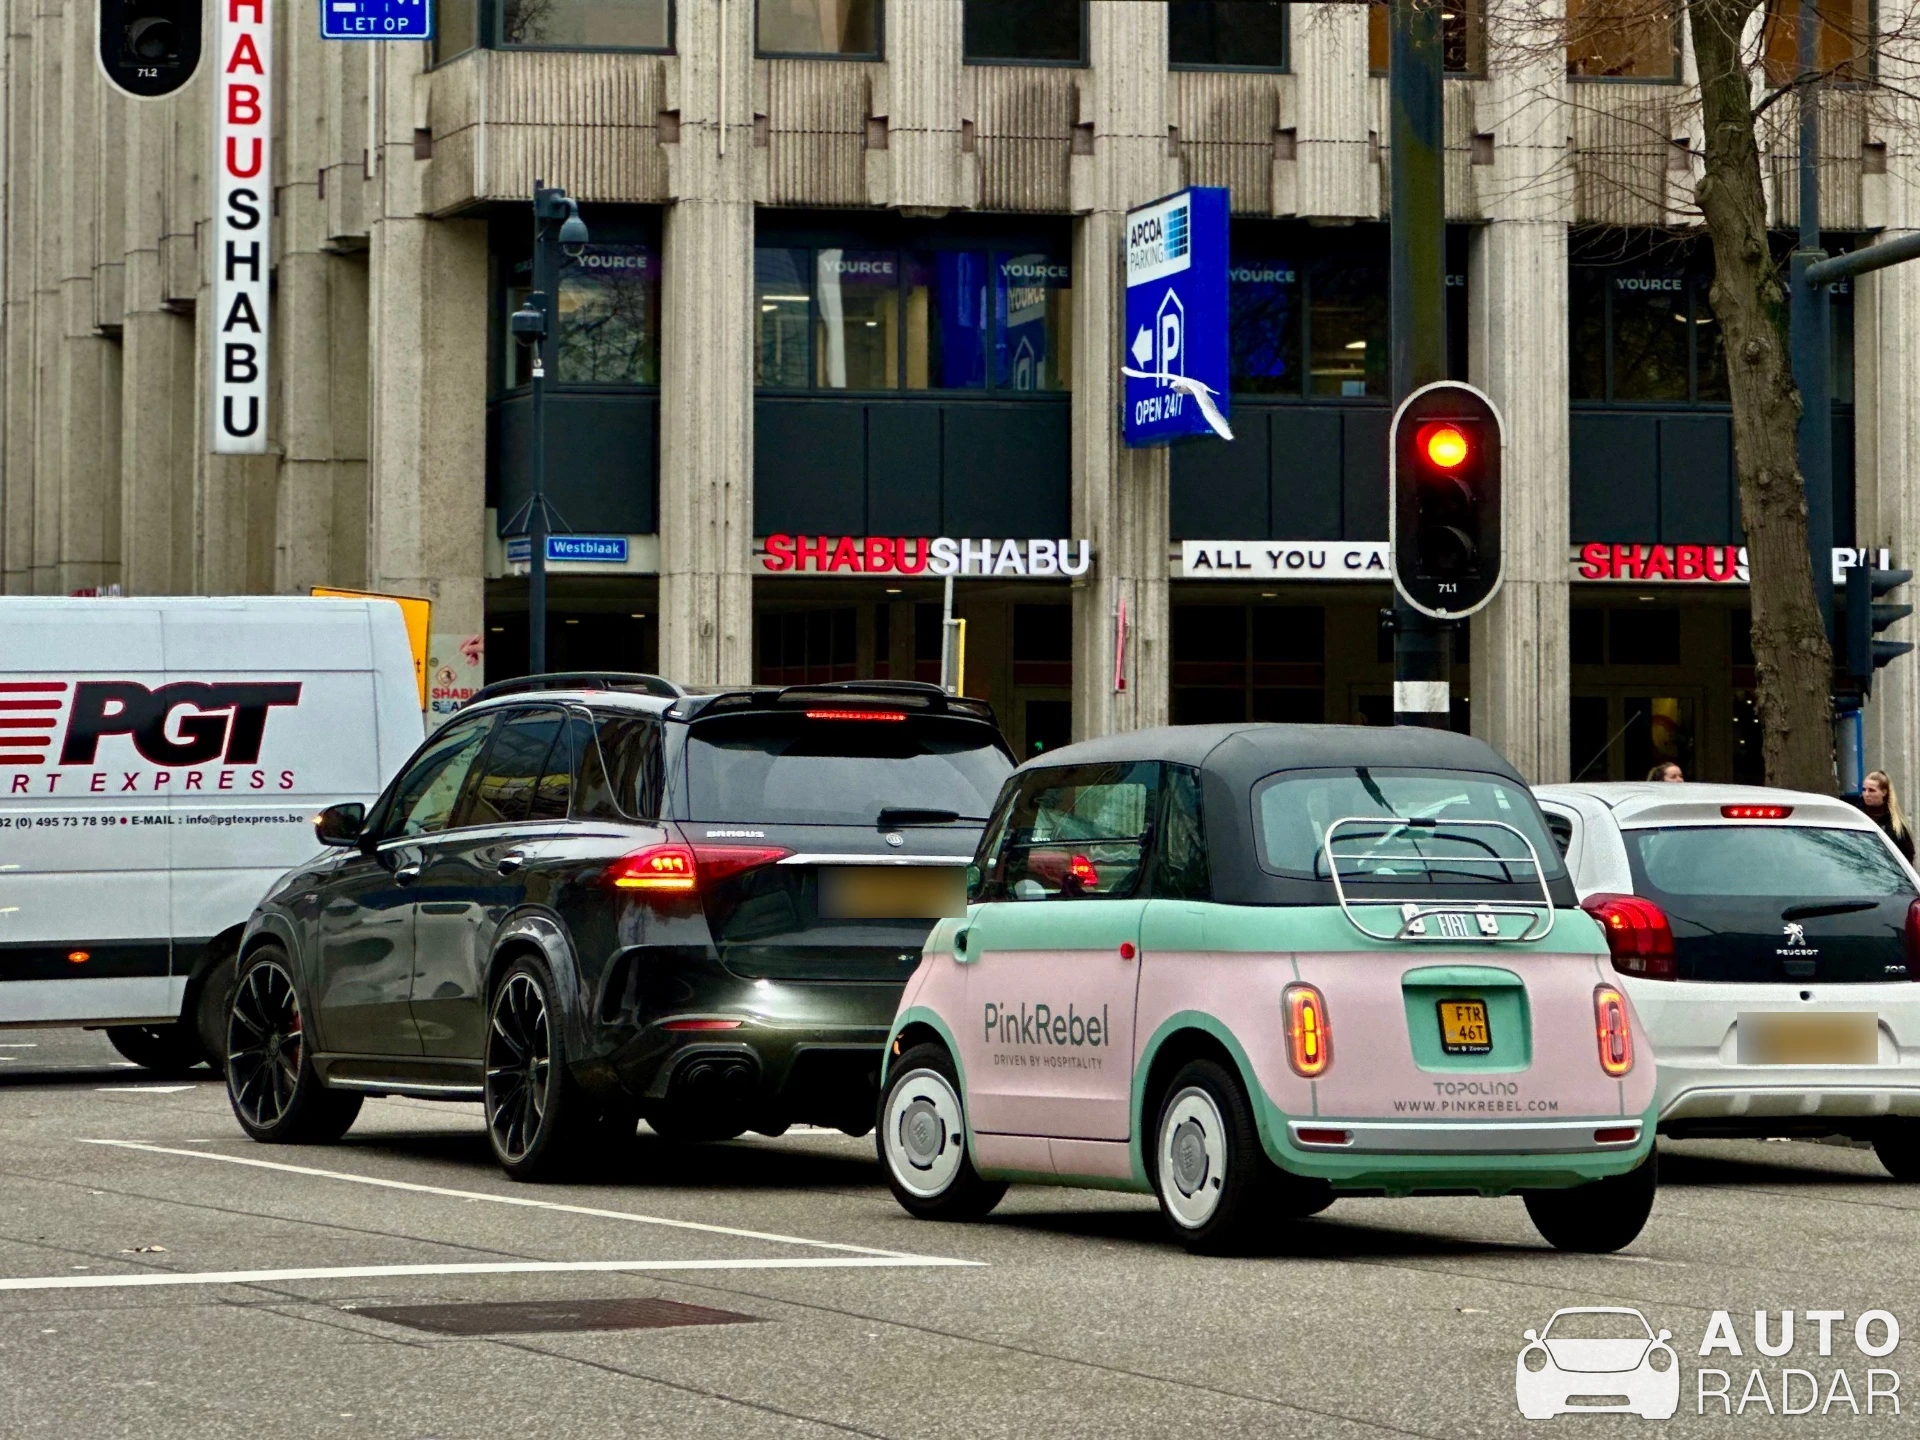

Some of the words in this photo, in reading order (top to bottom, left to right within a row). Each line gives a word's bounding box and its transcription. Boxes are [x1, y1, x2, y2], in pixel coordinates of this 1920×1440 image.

[343, 17, 377, 31] LET
[385, 17, 409, 31] OP
[138, 68, 157, 78] 71.2
[1131, 216, 1163, 248] APCOA
[577, 256, 647, 268] YOURCE
[1130, 243, 1164, 273] PARKING
[824, 261, 893, 274] YOURCE
[1001, 265, 1068, 278] YOURCE
[1229, 270, 1295, 282] YOURCE
[1617, 278, 1682, 291] YOURCE
[1135, 398, 1162, 425] OPEN
[1164, 393, 1183, 420] 24/7
[554, 541, 620, 554] Westblaak
[1193, 550, 1252, 569] ALL
[1266, 550, 1326, 569] YOU
[1344, 551, 1390, 570] CA
[1438, 583, 1457, 593] 71.1
[58, 681, 302, 767] PGT
[90, 770, 294, 793] EXPRESS
[15, 817, 32, 829] (0)
[36, 817, 59, 827] 495
[63, 816, 78, 827] 73
[82, 816, 97, 827] 78
[101, 816, 116, 826] 99
[131, 816, 174, 826] E-MAIL
[186, 814, 304, 825] info@pgtexpress.be
[1436, 913, 1469, 937] FIAT
[1456, 1006, 1483, 1022] FTR
[985, 1002, 1109, 1046] PinkRebel
[1459, 1025, 1483, 1041] 46T
[994, 1054, 1027, 1067] DRIVEN
[1030, 1055, 1040, 1067] BY
[1043, 1056, 1103, 1070] HOSPITALITY
[1394, 1101, 1559, 1112] WWW.PINKREBEL.COM
